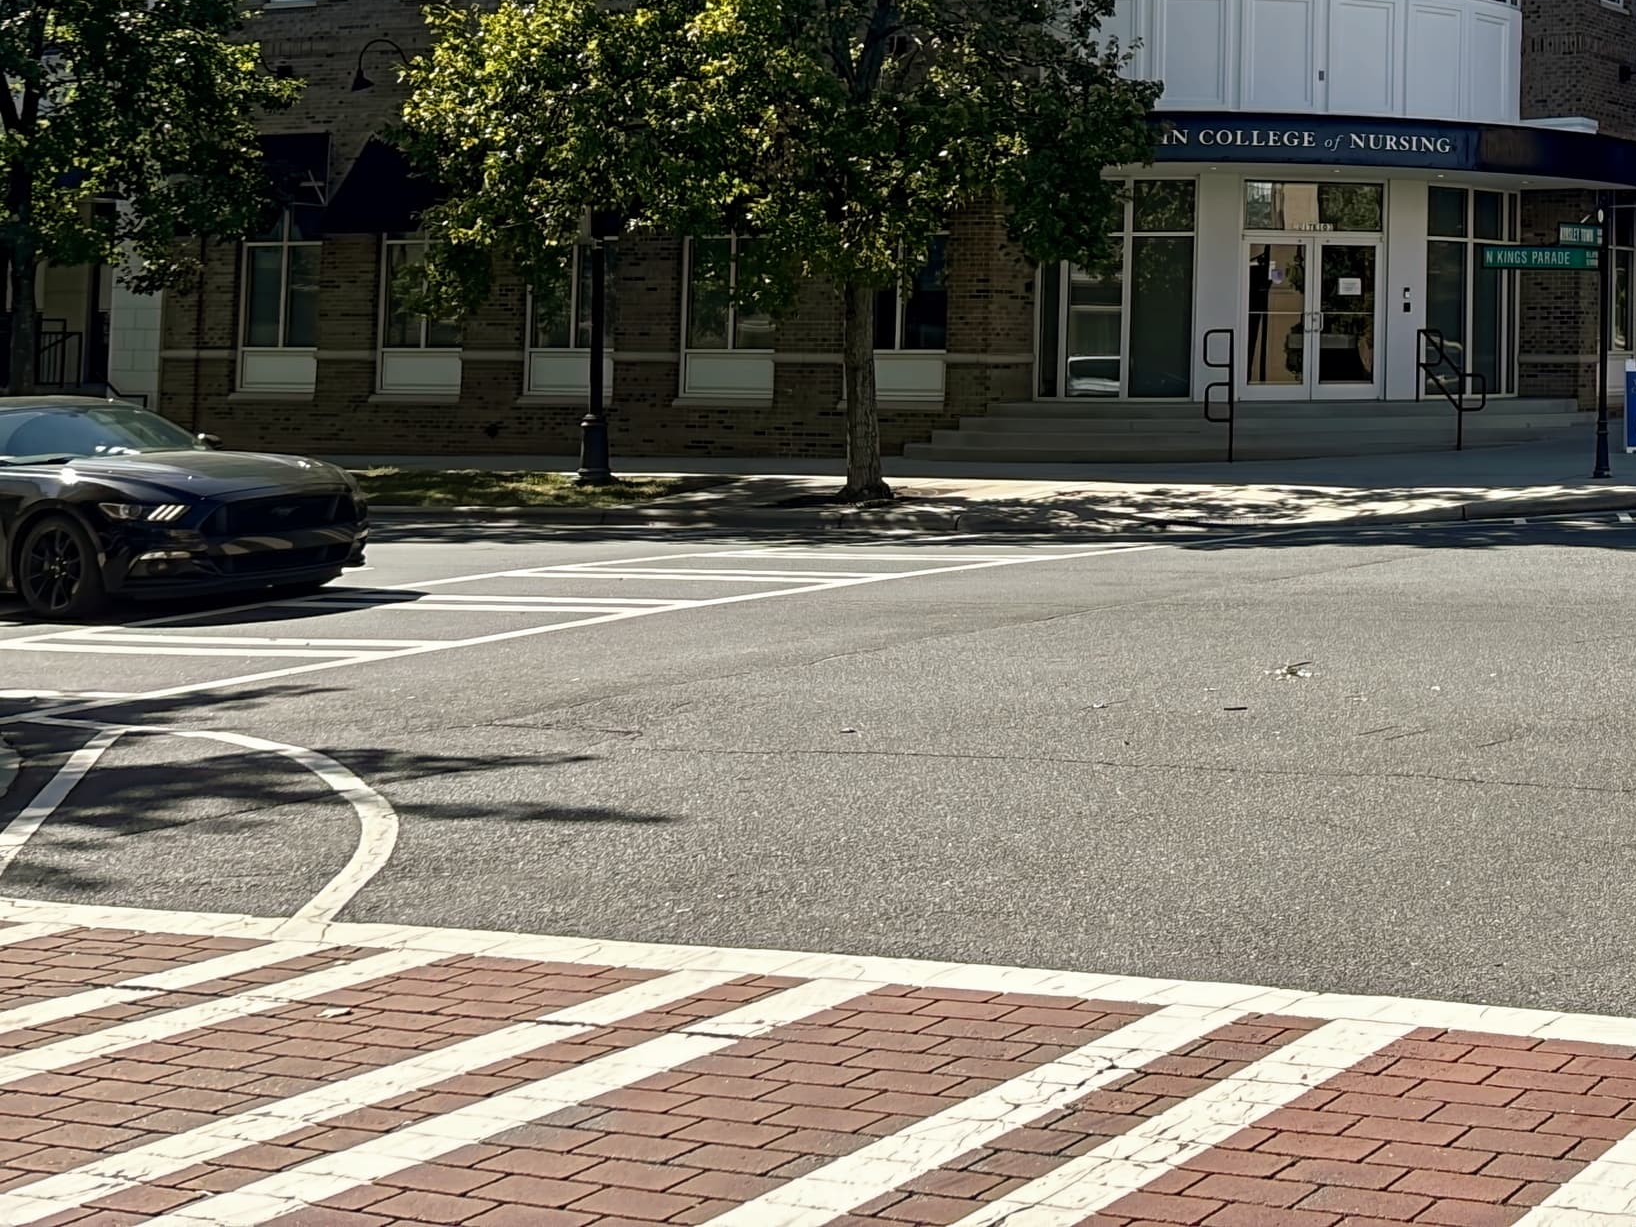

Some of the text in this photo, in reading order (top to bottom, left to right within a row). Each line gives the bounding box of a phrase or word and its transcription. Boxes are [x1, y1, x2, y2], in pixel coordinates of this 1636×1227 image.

[1198, 129, 1316, 147] COLLEGE
[1324, 134, 1345, 151] of
[1350, 132, 1451, 154] NURSING
[1486, 251, 1493, 264] N
[1497, 251, 1528, 264] KINGS
[1531, 251, 1571, 265] PARADE
